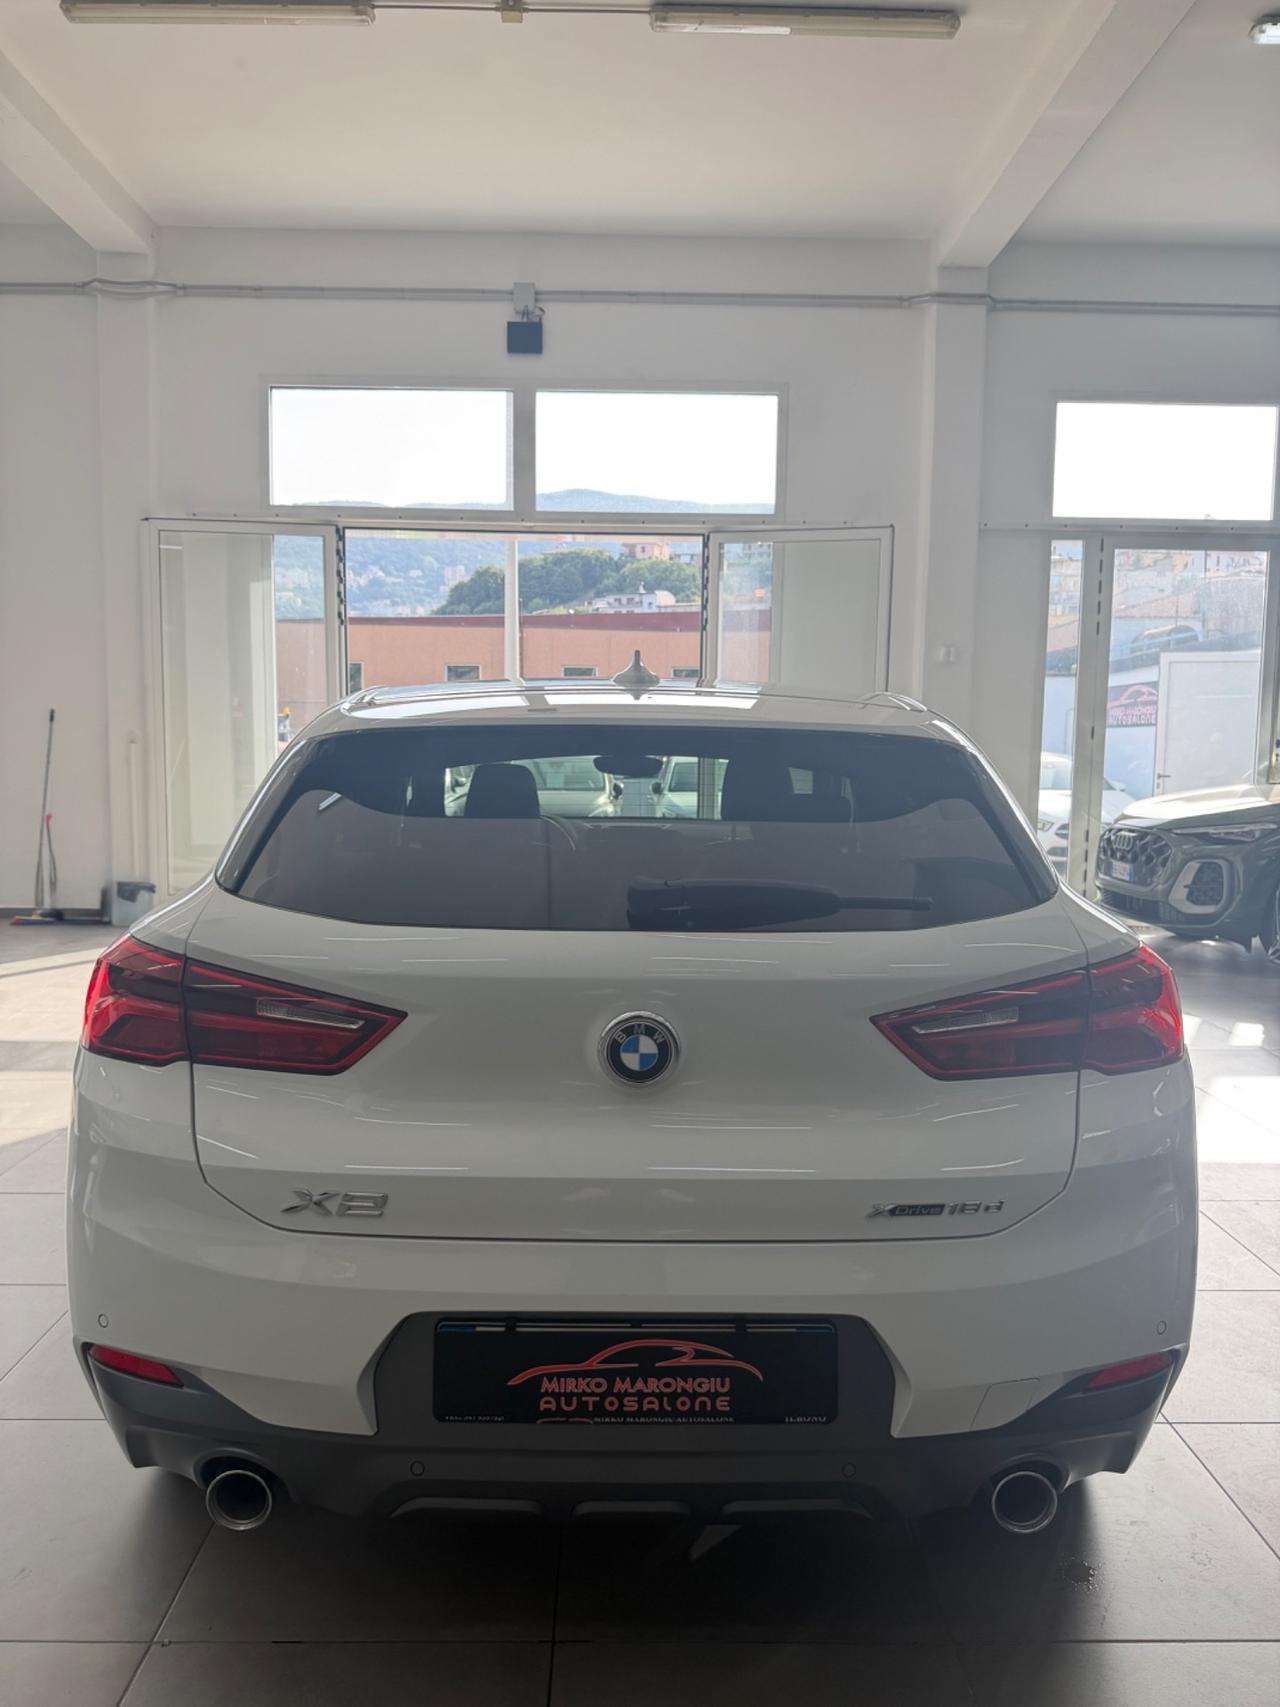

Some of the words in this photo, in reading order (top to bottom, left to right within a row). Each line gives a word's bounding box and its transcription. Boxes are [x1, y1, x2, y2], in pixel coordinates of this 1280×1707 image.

[615, 1023, 666, 1044] BMW
[280, 1187, 388, 1217] X2
[540, 1376, 608, 1393] MIRKO
[613, 1376, 730, 1393] MARONGIU
[539, 1396, 730, 1411] AUTOSALONE
